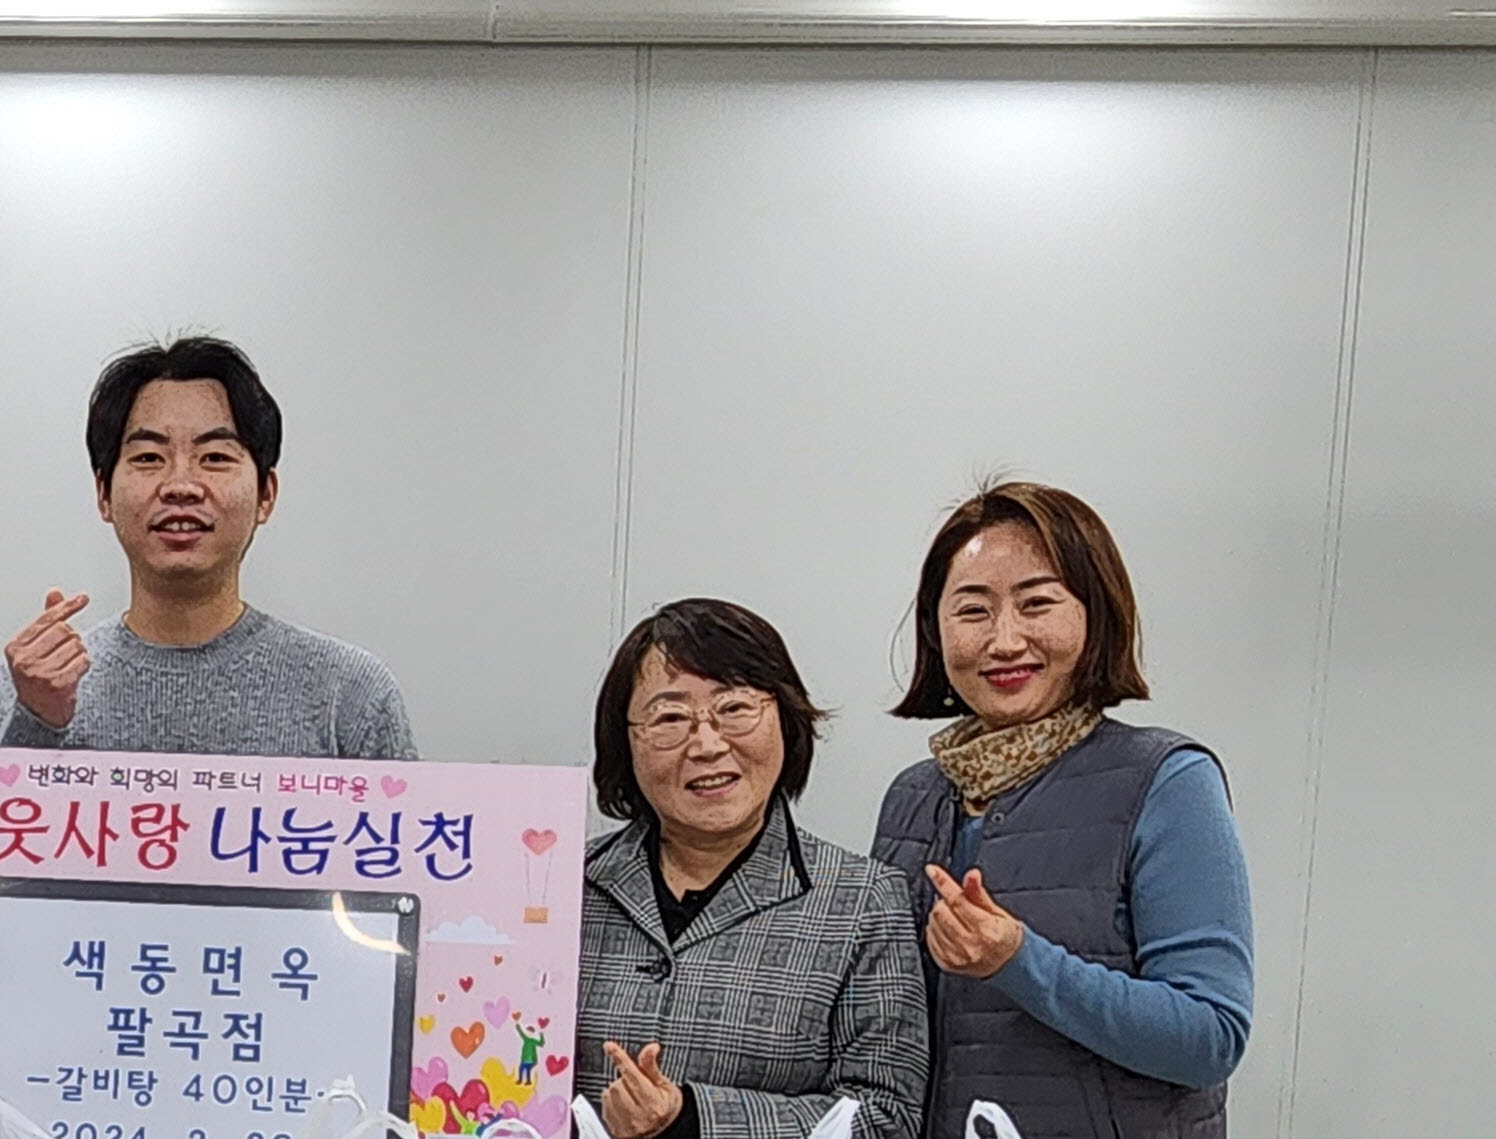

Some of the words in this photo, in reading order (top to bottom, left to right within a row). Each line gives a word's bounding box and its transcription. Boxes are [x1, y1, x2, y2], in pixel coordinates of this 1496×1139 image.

[28, 764, 99, 787] 변화와
[109, 767, 178, 791] 희망의
[193, 771, 262, 793] 파트너
[277, 773, 370, 802] 보니마을
[210, 805, 475, 881] 나눔실천
[107, 1007, 263, 1063] 팔곡점
